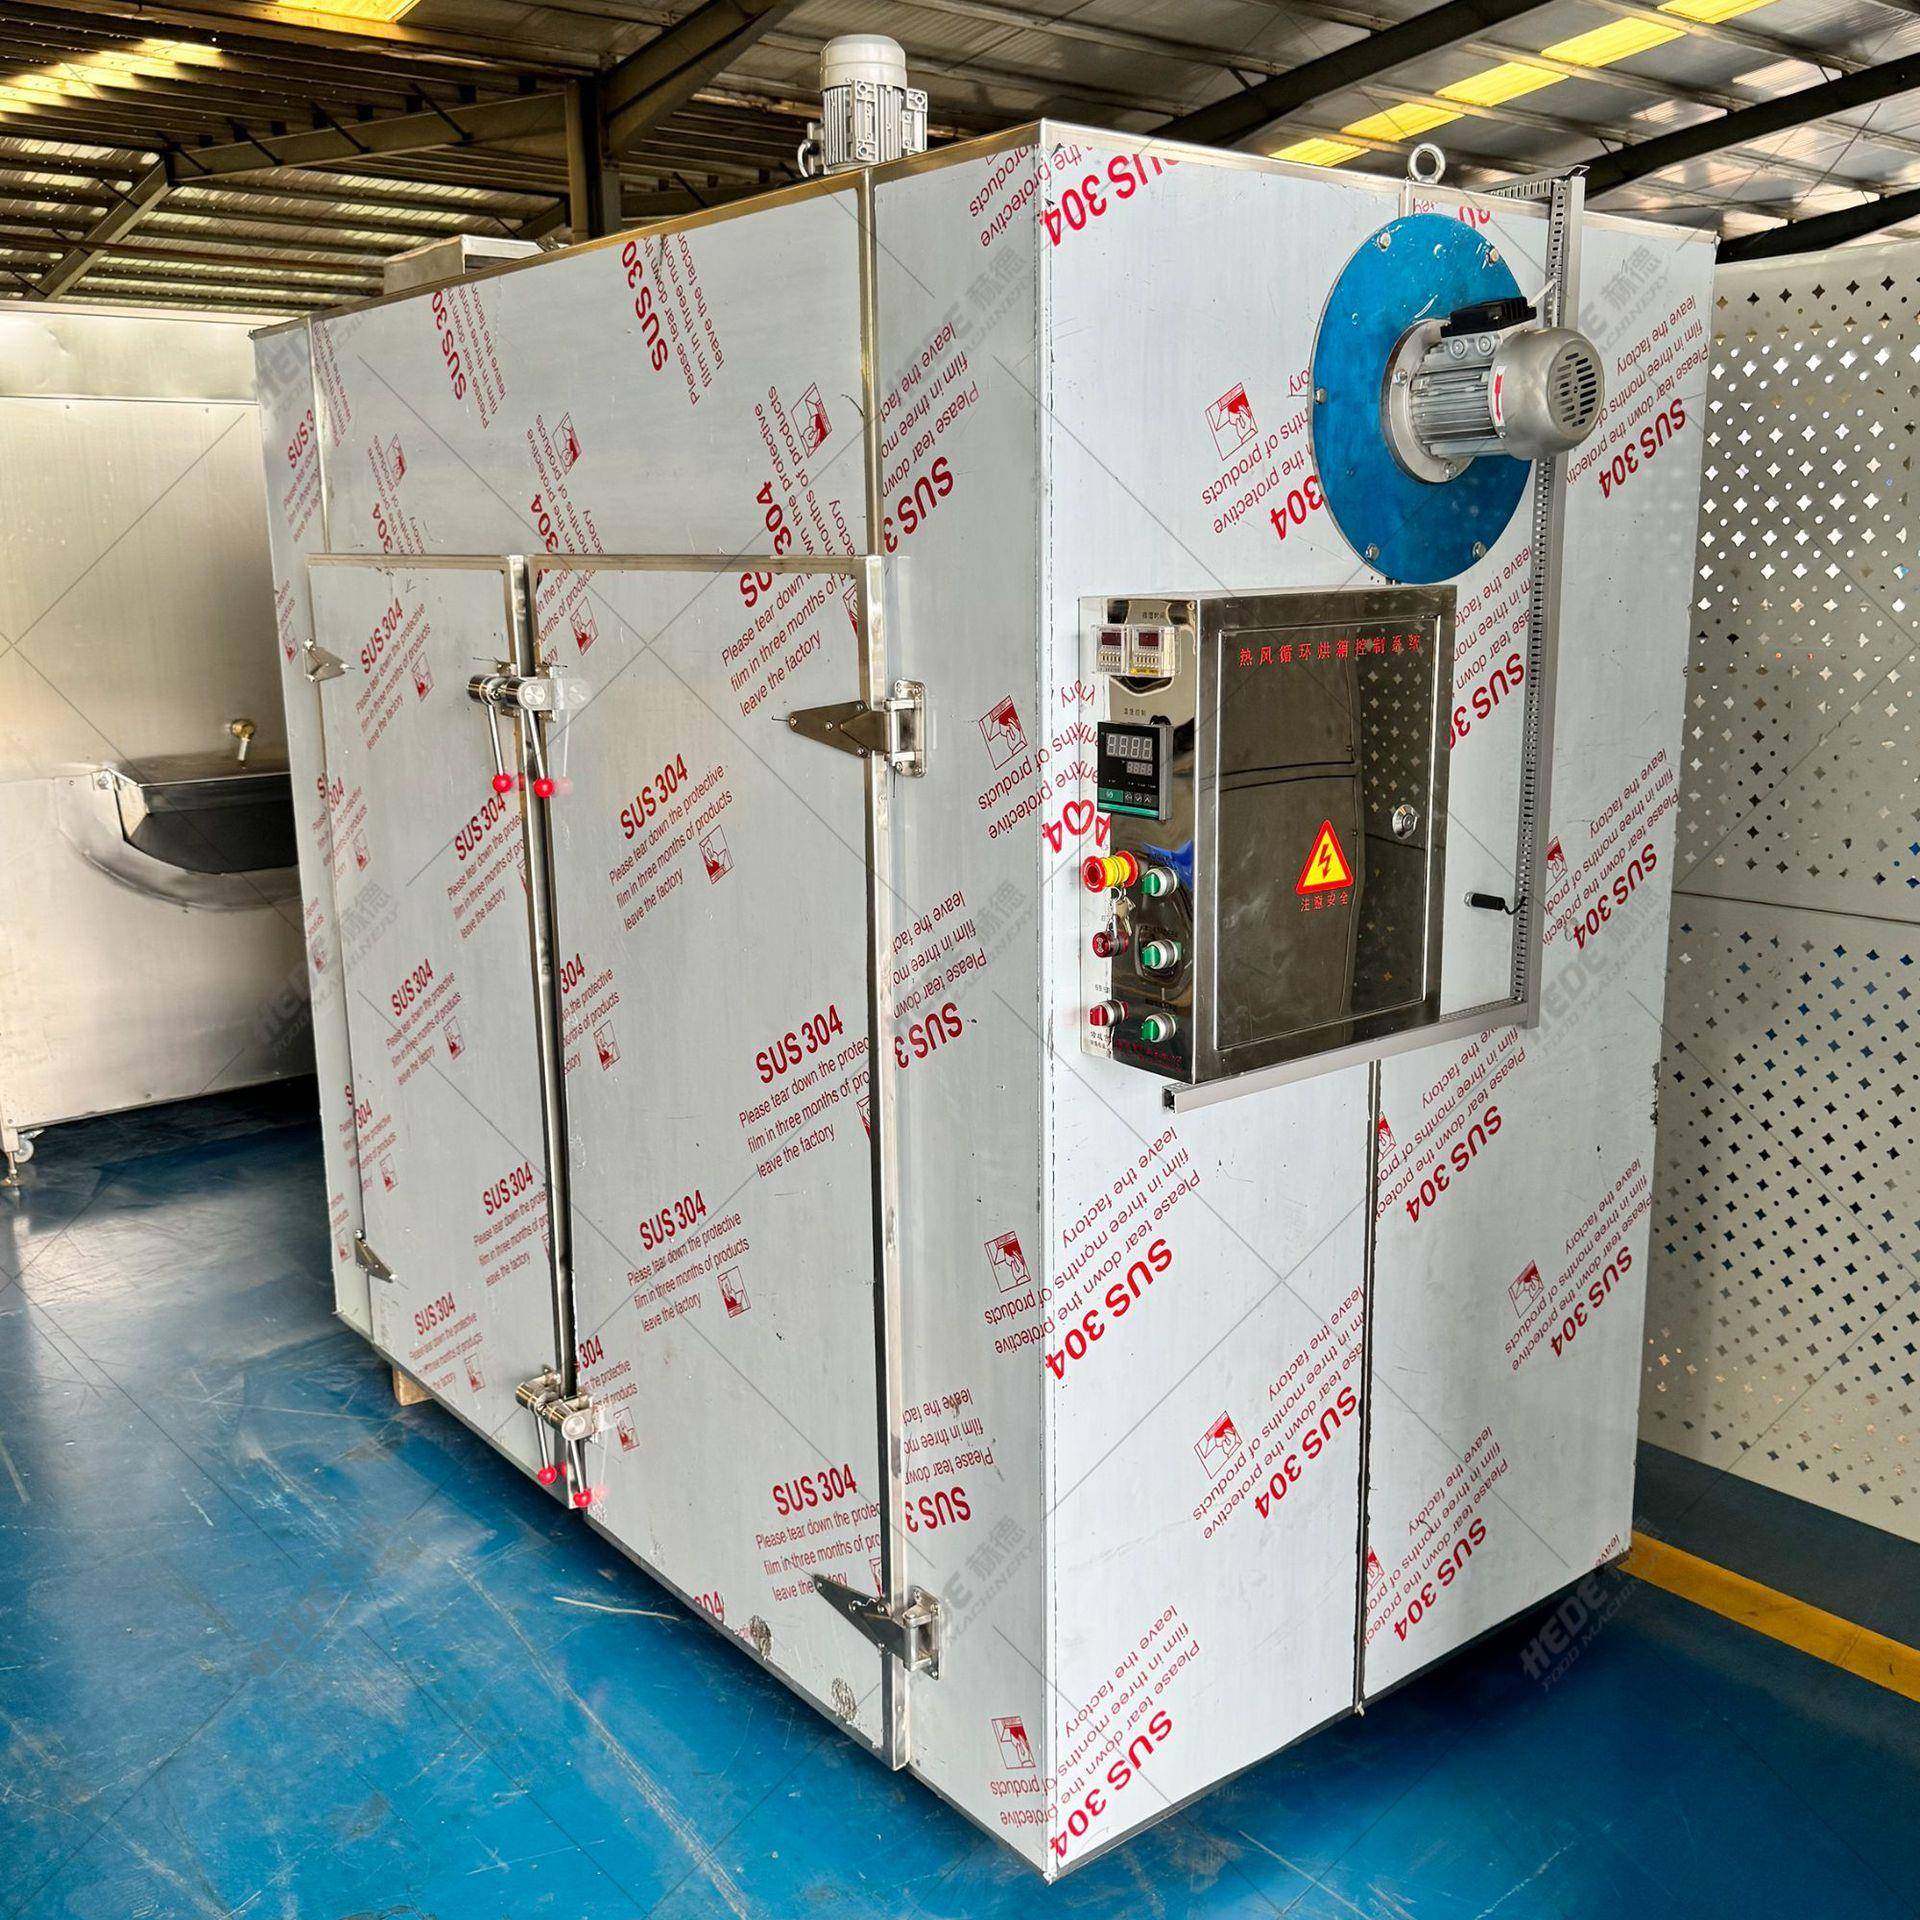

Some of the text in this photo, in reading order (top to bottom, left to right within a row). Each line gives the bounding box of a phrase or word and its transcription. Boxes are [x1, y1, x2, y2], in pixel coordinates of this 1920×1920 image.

[1043, 174, 1107, 247] 304
[442, 328, 466, 399] SUS
[635, 285, 668, 371] SUS
[649, 255, 699, 406] Please tear down
[675, 281, 711, 389] film in three
[693, 282, 724, 370] leave the
[900, 322, 956, 393] leave the
[1616, 294, 1696, 377] leave the factory
[898, 350, 967, 436] film in three
[1596, 318, 1702, 430] film in three months of
[1608, 342, 1707, 444] Please tear down the
[879, 379, 977, 498] Please tear down
[1598, 397, 1685, 499] SUS 304
[530, 491, 558, 559] 304
[755, 480, 791, 556] 304
[896, 455, 952, 534] SUS
[1269, 474, 1323, 542] 304
[360, 597, 402, 674] SUS 304
[1470, 652, 1523, 720] SUS
[619, 752, 688, 840] SUS 304
[978, 758, 1033, 811] products
[989, 788, 1053, 839] protective
[454, 787, 506, 861] SUS 304
[1573, 842, 1656, 950] SUS 304
[390, 958, 433, 1017] SUS 304
[559, 952, 585, 995] 304
[755, 1004, 843, 1084] SUS 304
[907, 1001, 962, 1058] SUS
[738, 1058, 836, 1128] Please tear down the
[746, 1076, 851, 1153] film in three months of
[482, 1162, 533, 1216] SUS 304
[755, 1123, 834, 1178] leave the factory
[1067, 1126, 1178, 1245] leave the factory
[1147, 1173, 1164, 1191] in
[1161, 1146, 1189, 1176] film
[1405, 1104, 1502, 1223] SUS 304
[638, 1190, 706, 1250] SUS 304
[1110, 1189, 1148, 1230] three
[1565, 1157, 1641, 1255] leave the factory
[625, 1212, 740, 1287] Please tear down the protective
[632, 1237, 748, 1311] film in three months of products
[995, 1168, 1200, 1354] Please tear down the protective
[1057, 1227, 1110, 1285] months
[1504, 1173, 1647, 1353] film in three months of products
[1511, 1191, 1653, 1370] Please tear down the protective
[414, 1290, 455, 1335] SUS 304
[639, 1292, 701, 1333] leave the factory
[984, 1290, 1036, 1325] products
[1046, 1237, 1172, 1380] SUS 304
[1549, 1246, 1631, 1357] SUS 304
[1268, 1287, 1361, 1402] leave the factory
[1192, 1330, 1349, 1521] in three months of products
[1202, 1370, 1341, 1539] tear down the protective
[1253, 1385, 1356, 1519] SUS 304
[772, 1463, 857, 1516] SUS 304
[918, 1486, 970, 1530] SUS
[1393, 1517, 1487, 1642] SUS 304
[1050, 1708, 1172, 1858] SUS 304
